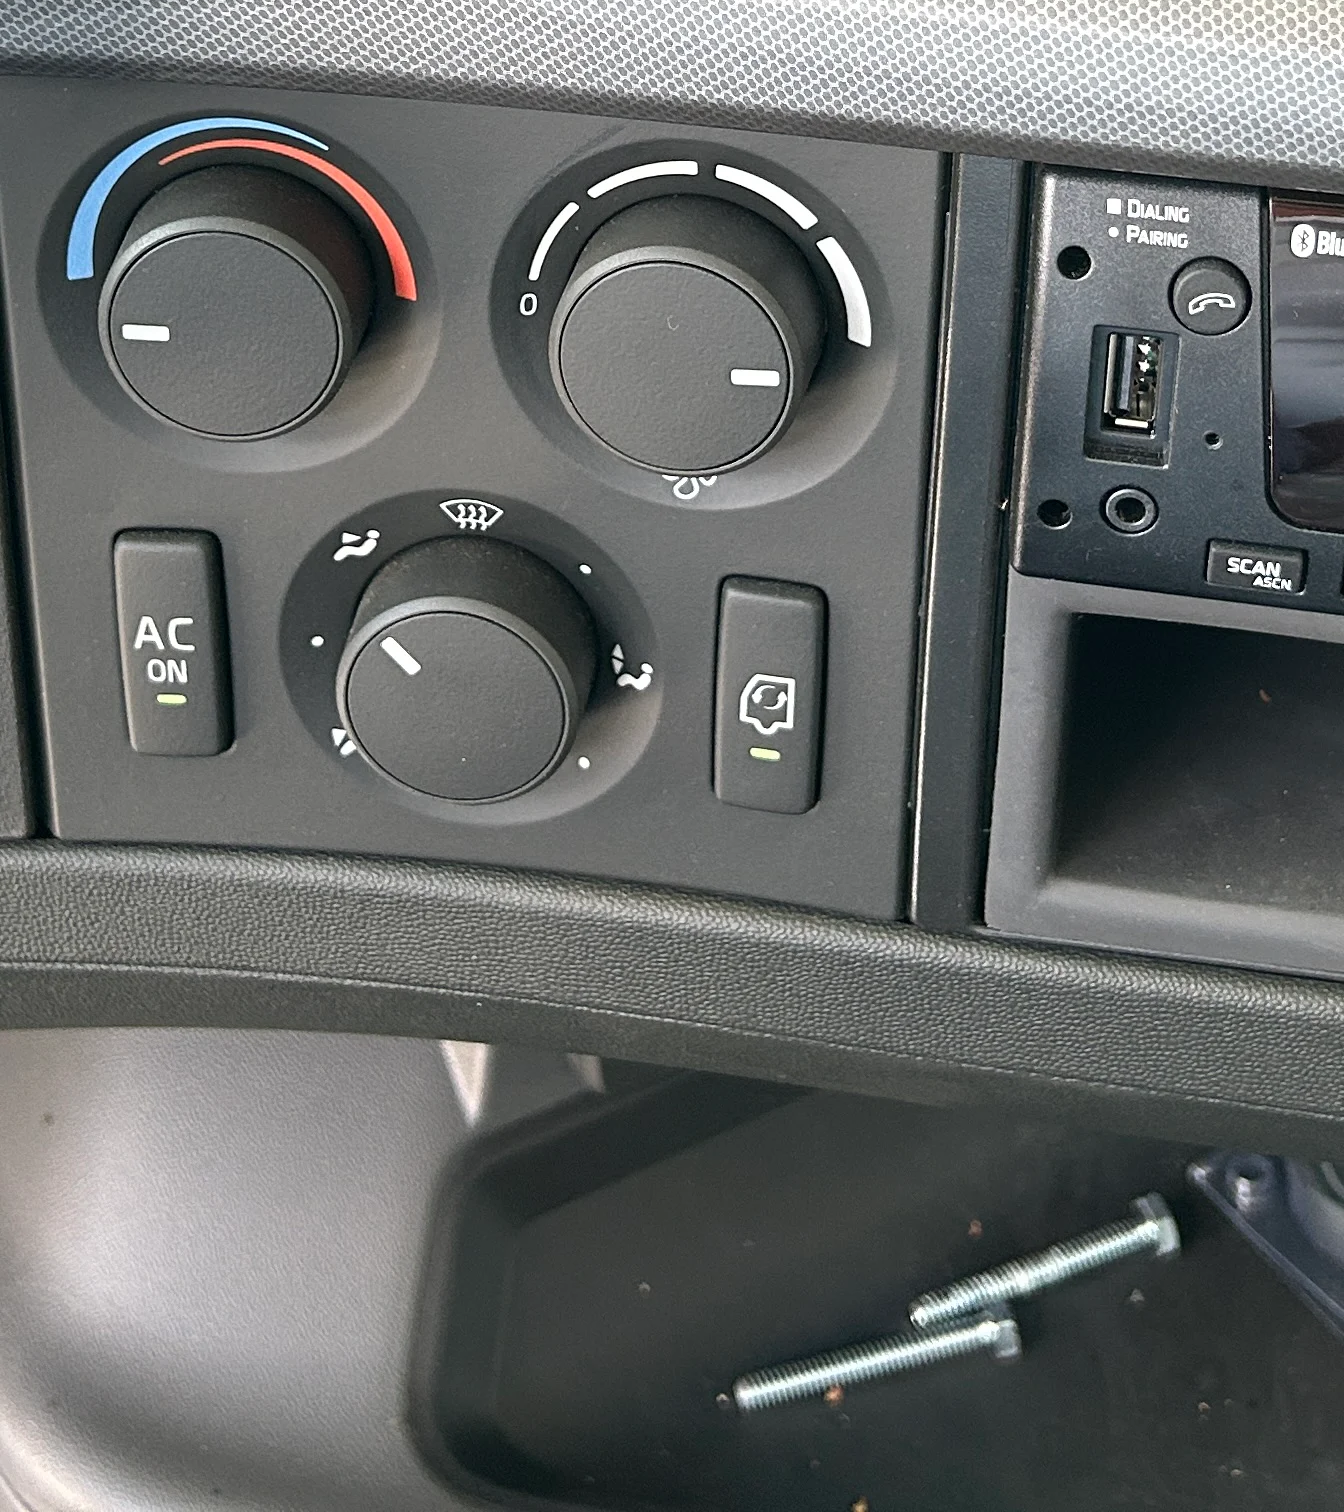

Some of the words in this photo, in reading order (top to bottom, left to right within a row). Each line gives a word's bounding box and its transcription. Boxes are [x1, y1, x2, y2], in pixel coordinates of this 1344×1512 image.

[1227, 557, 1282, 579] SCAN
[1253, 576, 1293, 591] ASCN
[134, 615, 196, 651] AC
[146, 658, 189, 684] ON
